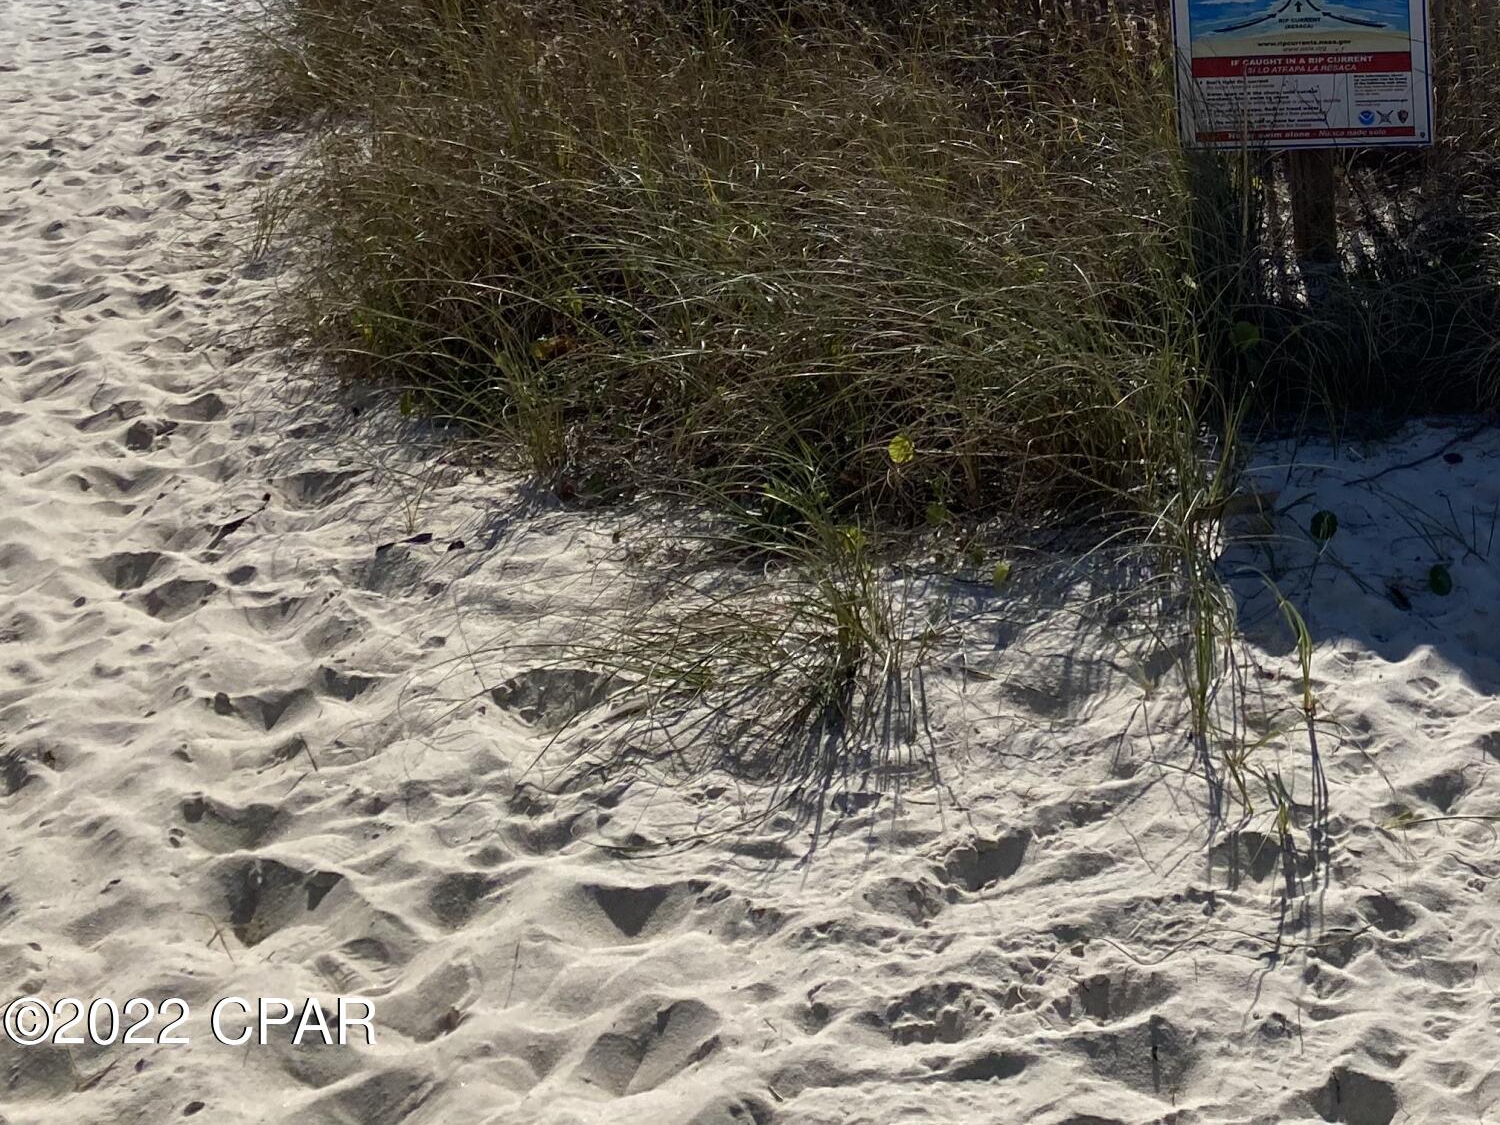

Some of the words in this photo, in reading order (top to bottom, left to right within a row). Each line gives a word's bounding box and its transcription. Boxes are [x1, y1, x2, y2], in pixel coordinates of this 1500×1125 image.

[1242, 58, 1282, 66] CAUGHT
[1327, 55, 1374, 63] CURRENT
[1320, 64, 1357, 72] RESACA
